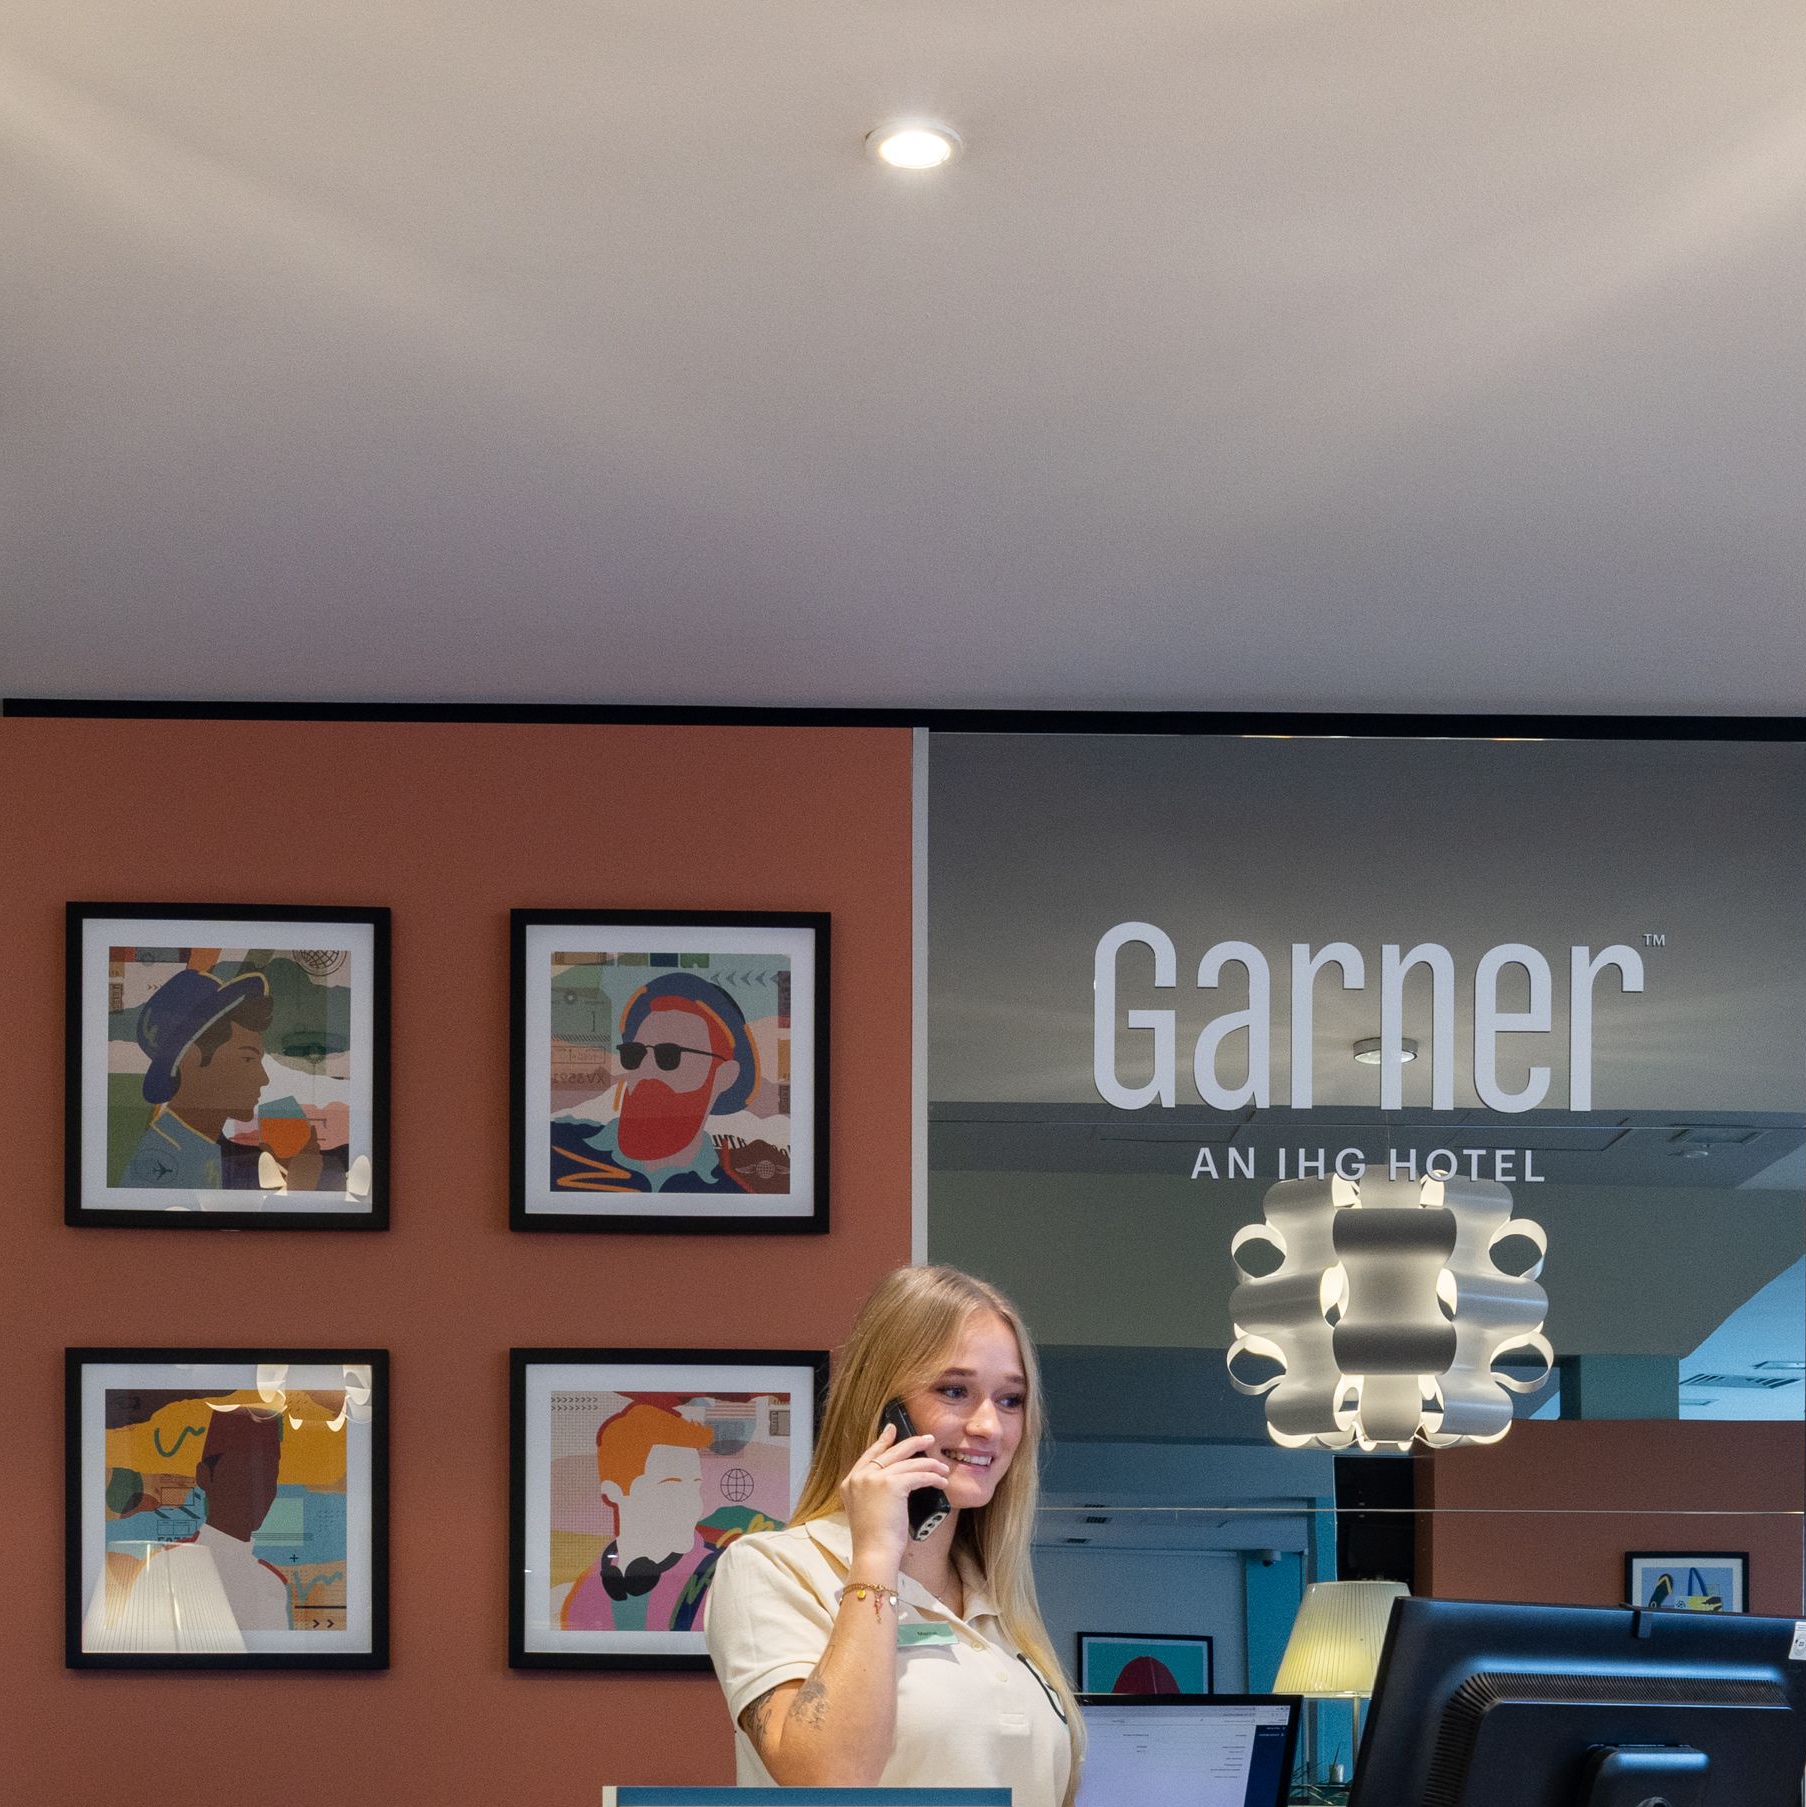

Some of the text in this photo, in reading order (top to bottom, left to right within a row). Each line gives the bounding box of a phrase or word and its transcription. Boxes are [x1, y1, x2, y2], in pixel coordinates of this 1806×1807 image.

[1091, 921, 1645, 1112] Garner
[1190, 1146, 1545, 1183] AN IHG HOTEL
